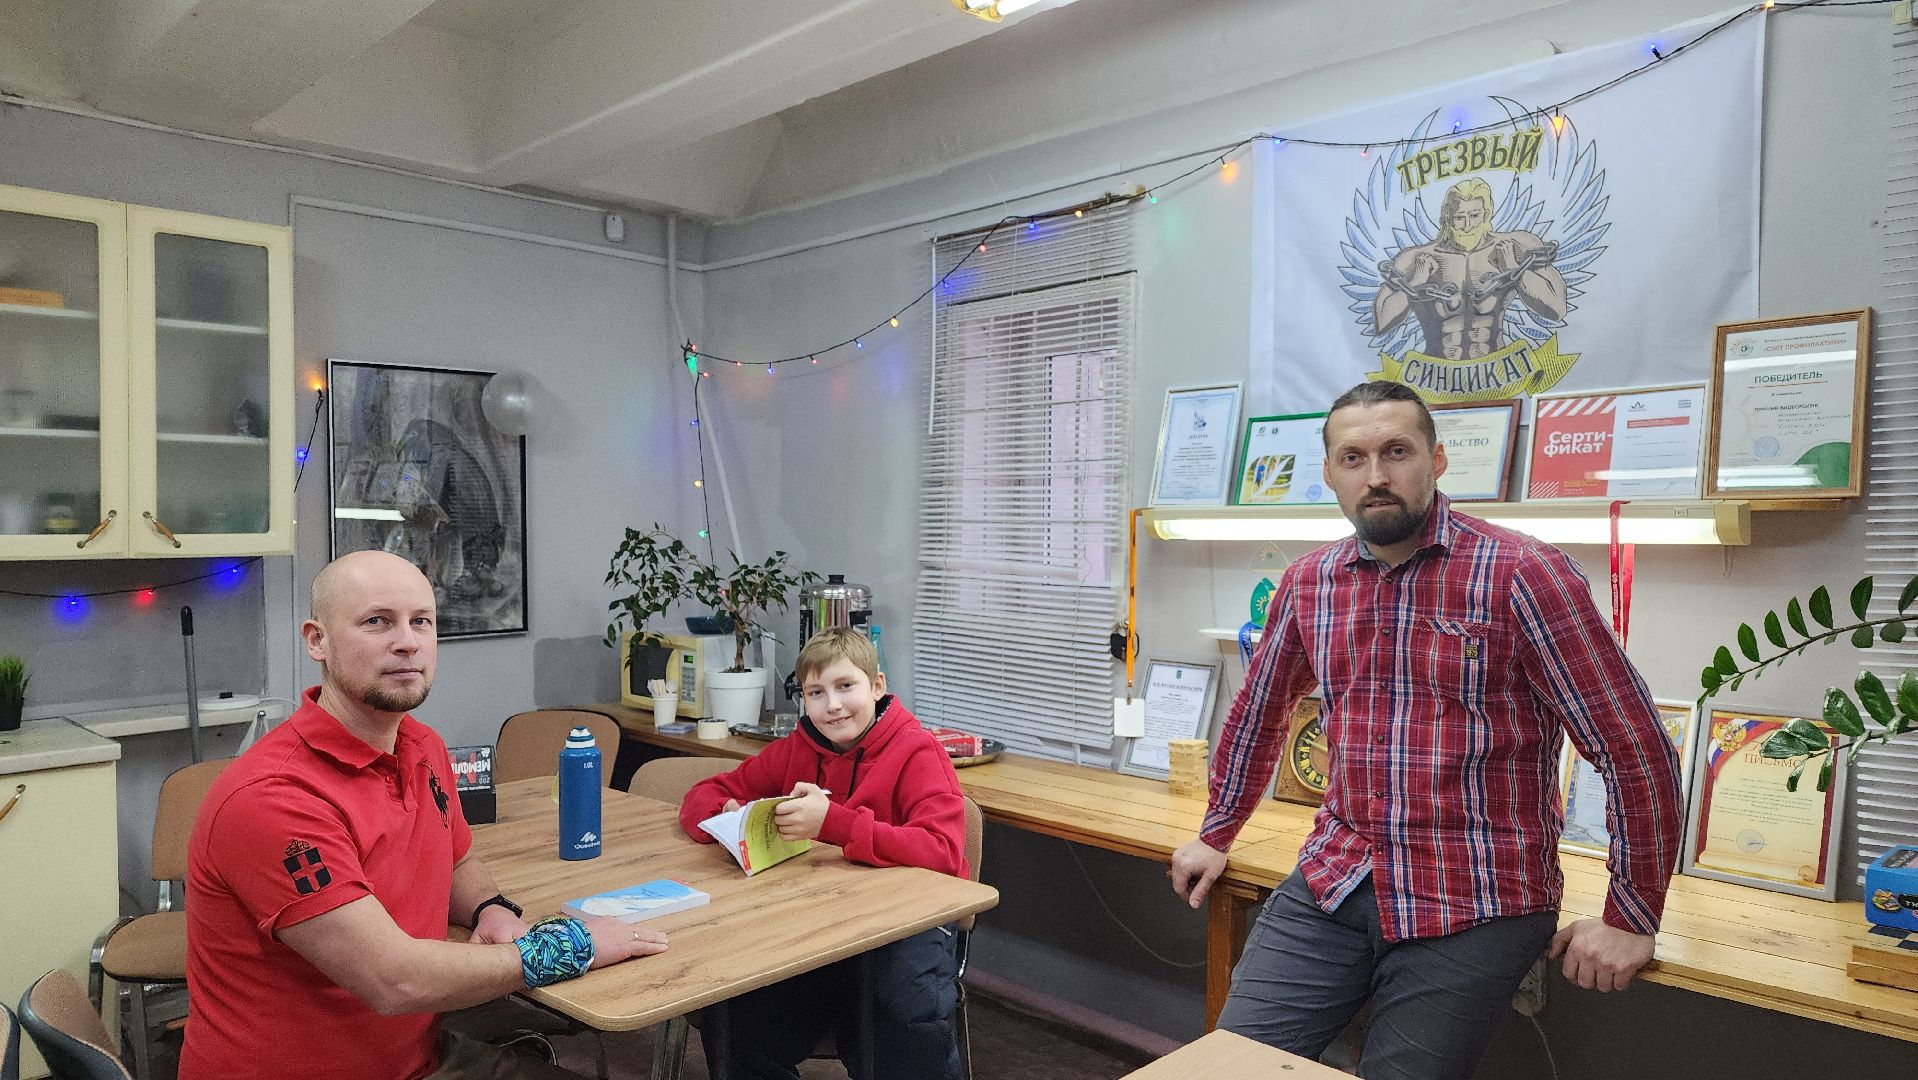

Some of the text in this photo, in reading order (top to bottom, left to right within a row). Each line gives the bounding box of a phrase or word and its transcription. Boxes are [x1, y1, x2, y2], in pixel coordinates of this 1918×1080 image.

[1397, 128, 1543, 191] ТРЕЗВЫЙ
[1404, 347, 1534, 393] СИНДИКАТ
[1754, 371, 1823, 384] ПОБЕДИТЕЛЬ
[1441, 437, 1489, 448] ЛЬСТВО
[1549, 431, 1613, 445] Серти-
[1544, 441, 1603, 458] фикат
